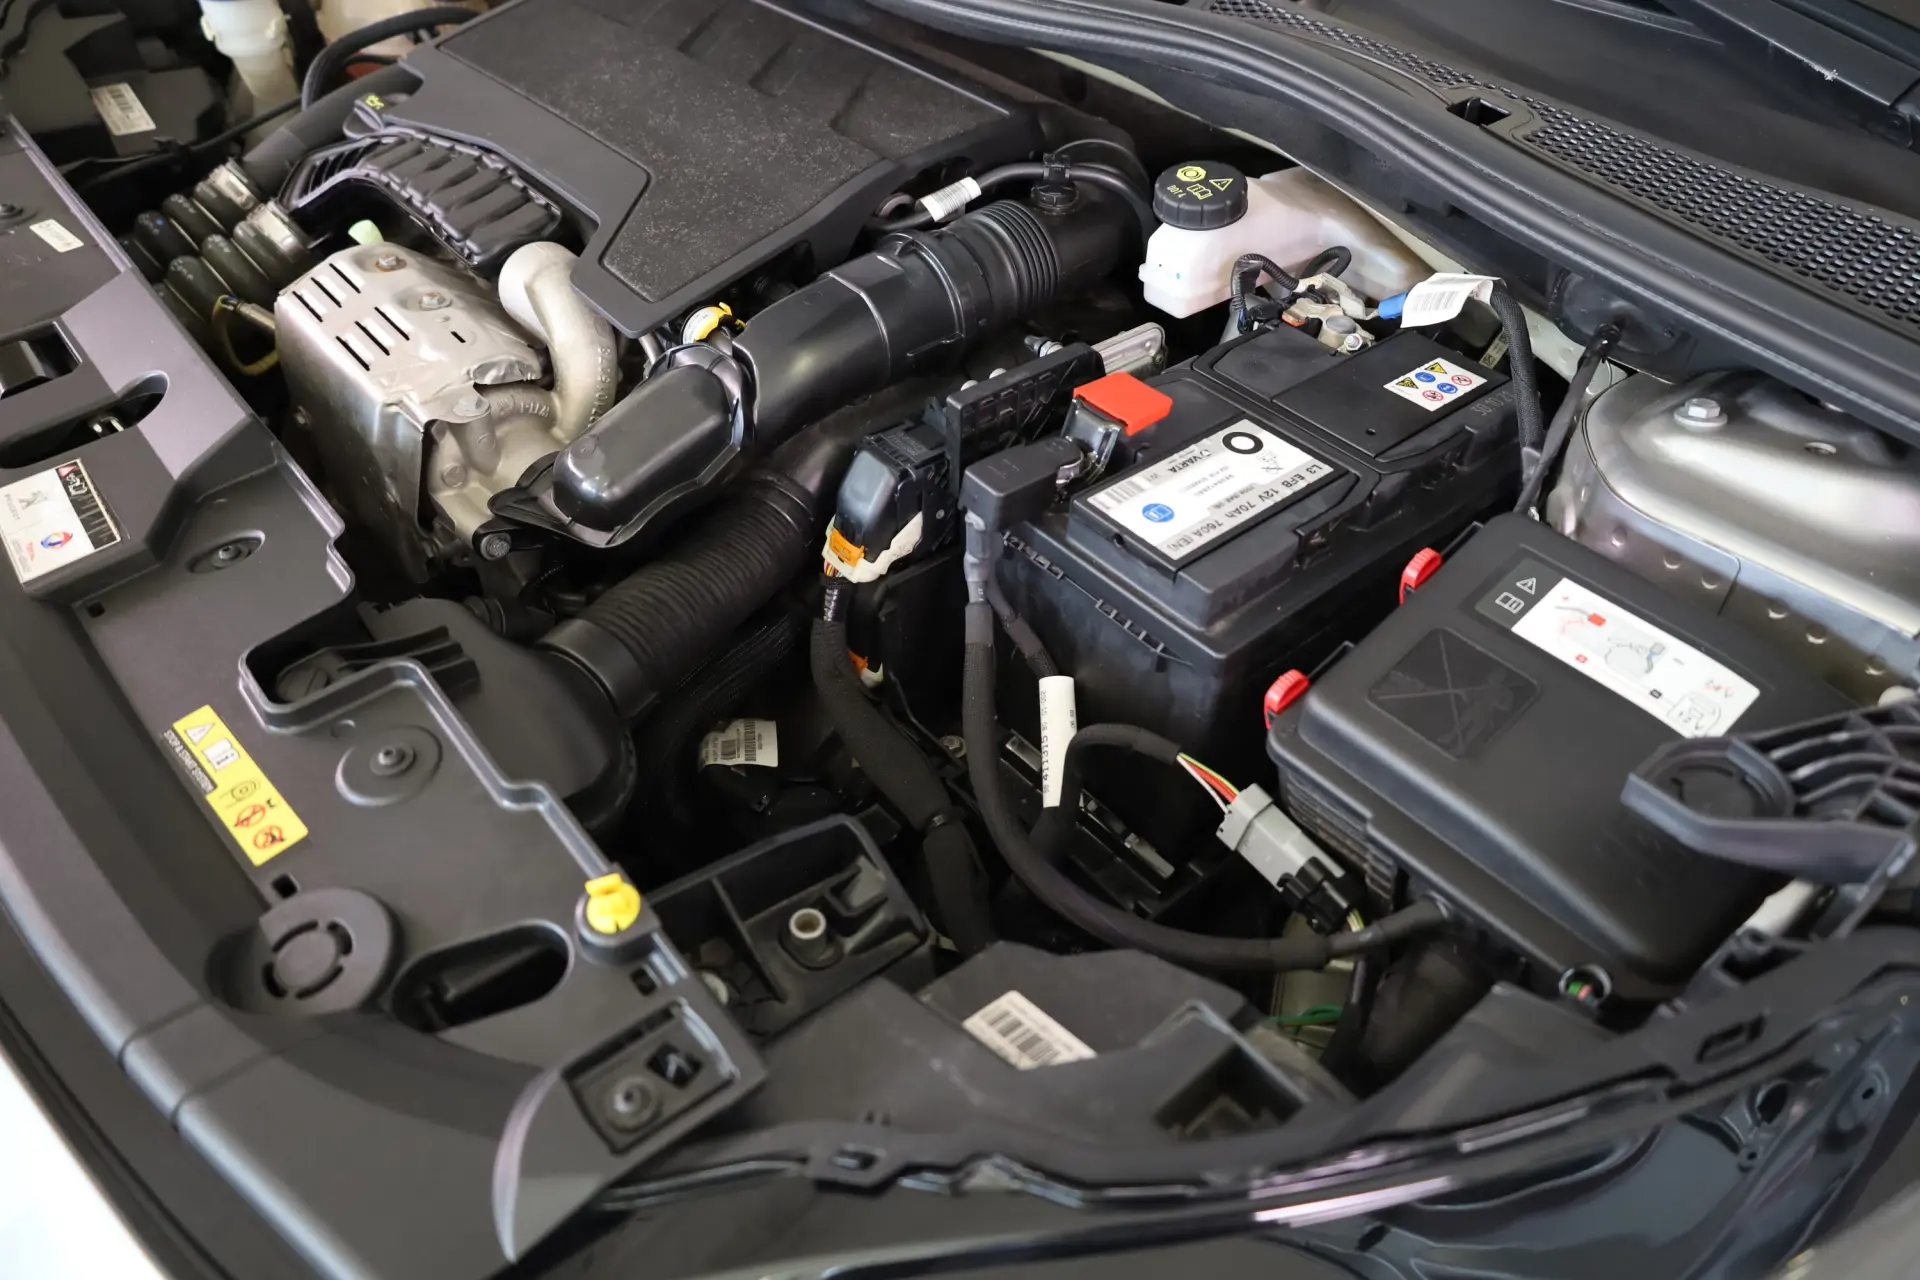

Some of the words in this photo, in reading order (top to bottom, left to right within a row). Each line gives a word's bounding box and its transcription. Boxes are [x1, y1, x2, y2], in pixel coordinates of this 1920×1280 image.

[1167, 184, 1183, 194] DOT
[1168, 455, 1203, 474] VARTA
[1305, 464, 1323, 474] L3
[1281, 473, 1305, 487] EFB
[1257, 488, 1280, 502] 12V
[1225, 502, 1256, 519] 70Ah
[1192, 519, 1223, 538] 760A
[1165, 534, 1194, 552] (EN)
[162, 728, 181, 748] STOP
[178, 748, 199, 772] START
[190, 766, 214, 794] SYSTEM
